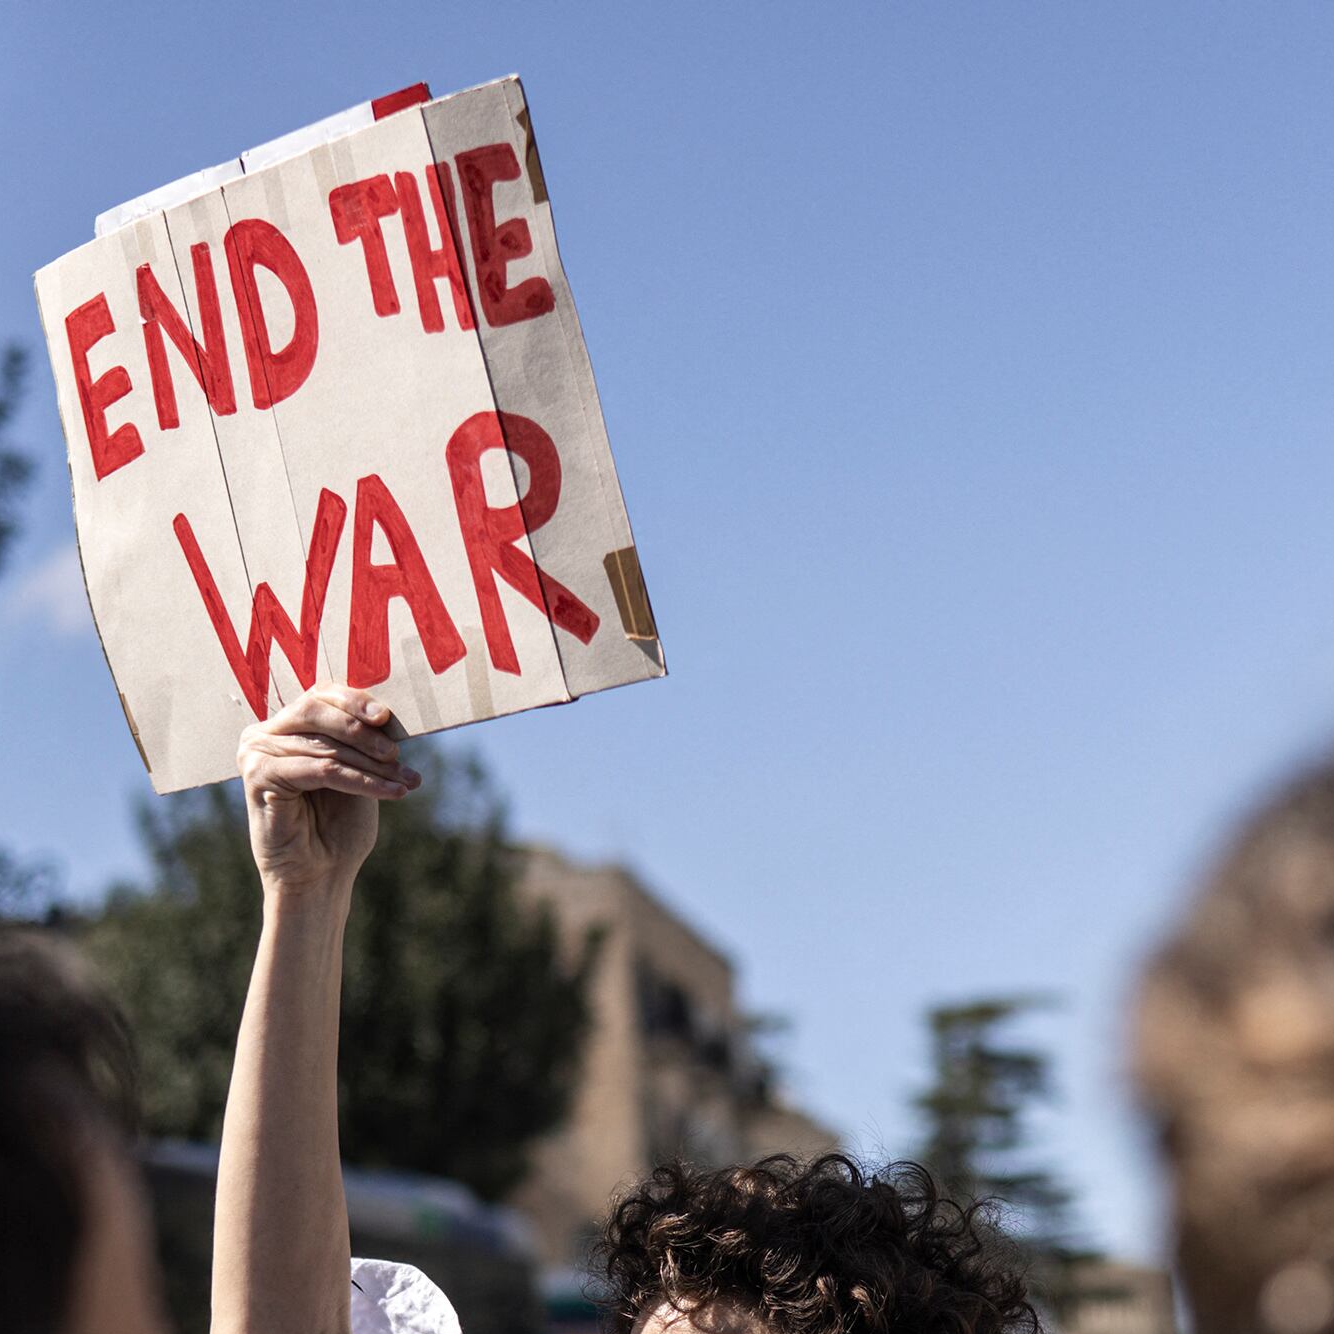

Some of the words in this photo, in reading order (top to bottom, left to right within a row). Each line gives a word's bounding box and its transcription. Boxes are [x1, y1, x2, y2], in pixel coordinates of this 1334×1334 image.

[64, 218, 319, 482] END
[328, 143, 556, 333] THE
[172, 408, 600, 722] WAR
